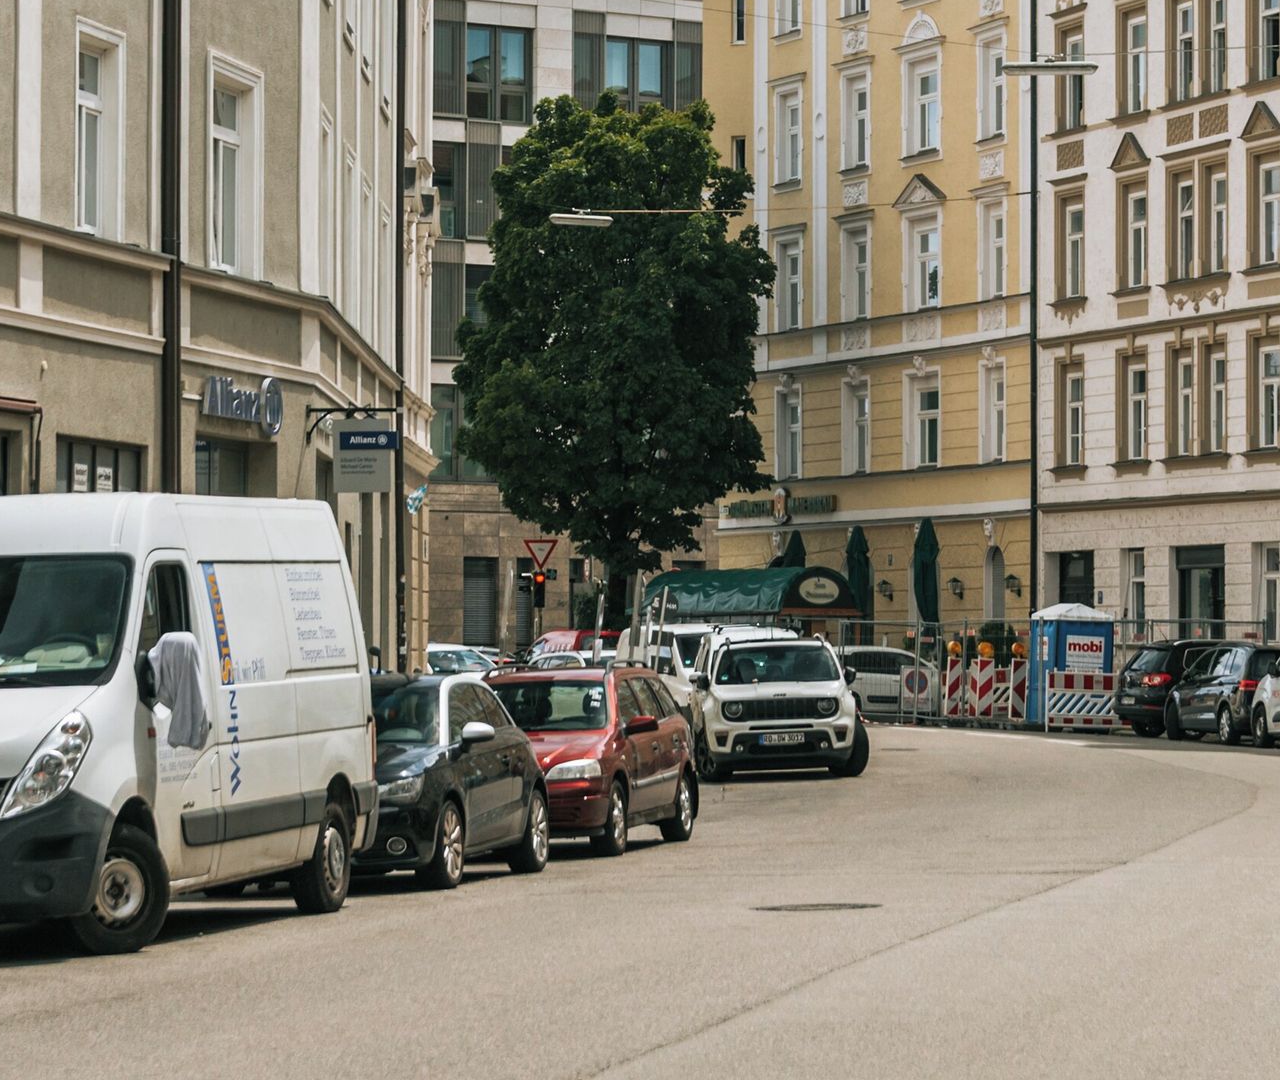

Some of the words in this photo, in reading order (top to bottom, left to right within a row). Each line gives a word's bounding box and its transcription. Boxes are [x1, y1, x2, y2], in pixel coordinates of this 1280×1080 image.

[202, 376, 261, 424] Allianz
[349, 435, 377, 444] Allianz
[1068, 640, 1102, 653] mobi
